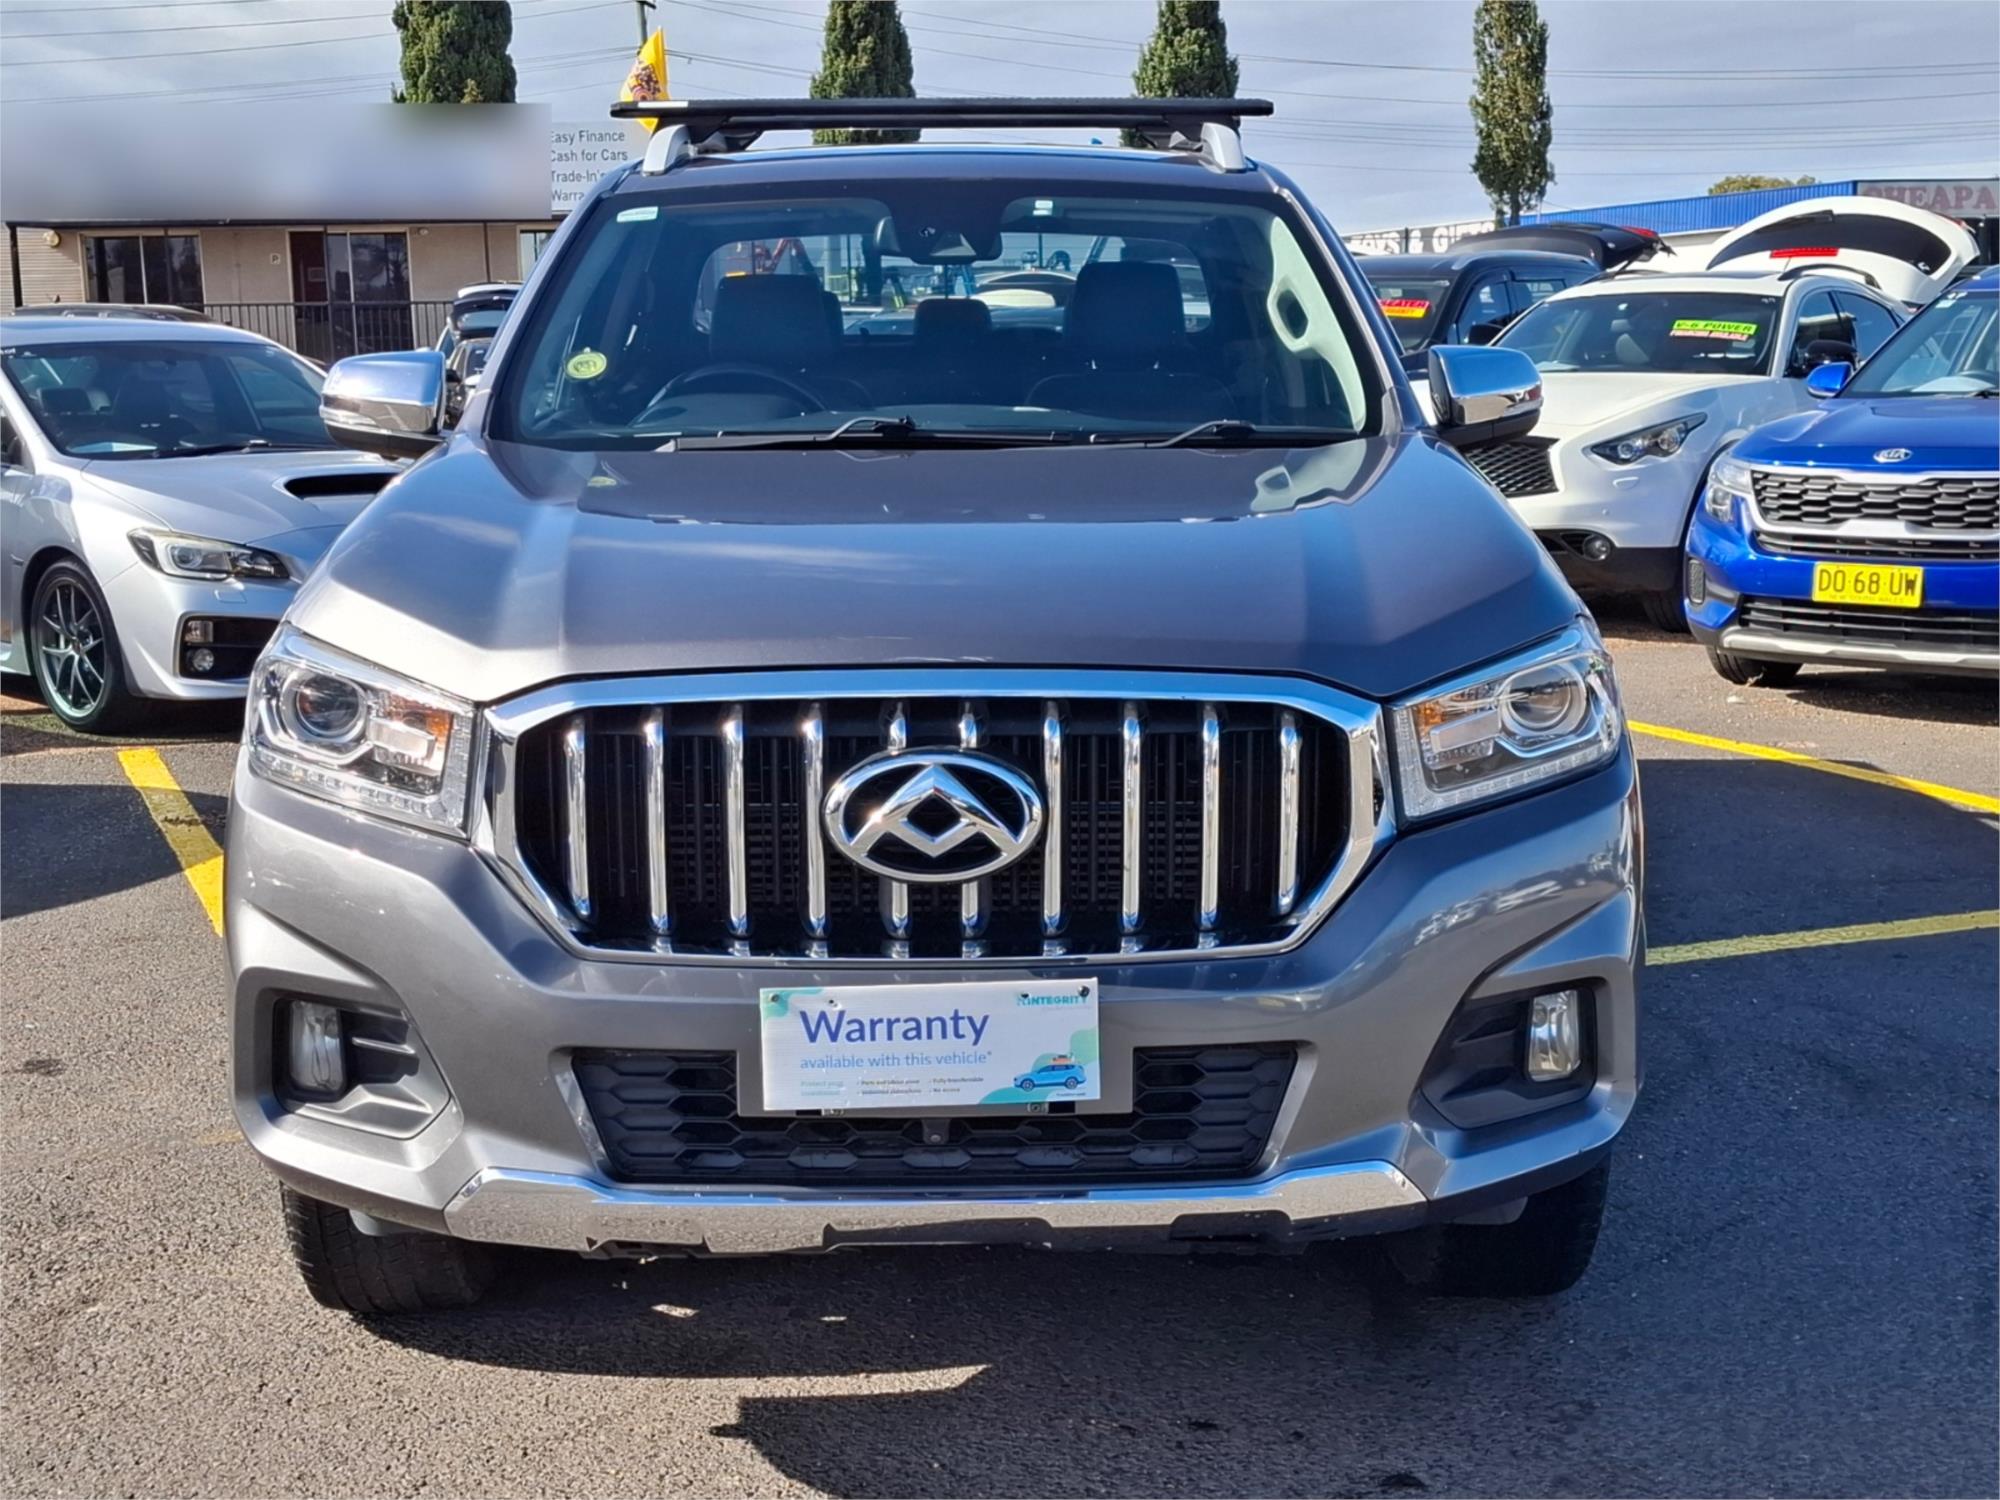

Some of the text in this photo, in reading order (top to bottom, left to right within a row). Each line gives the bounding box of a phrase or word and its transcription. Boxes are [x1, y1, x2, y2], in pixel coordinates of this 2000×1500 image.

[578, 130, 625, 142] Finance
[581, 148, 597, 161] for
[601, 148, 628, 161] Cars
[1409, 229, 1424, 254] &
[1703, 322, 1753, 332] POWER
[1854, 571, 1880, 595] 68
[799, 1008, 990, 1046] Warranty
[800, 1053, 864, 1070] available
[868, 1053, 901, 1068] with
[905, 1051, 932, 1067] this
